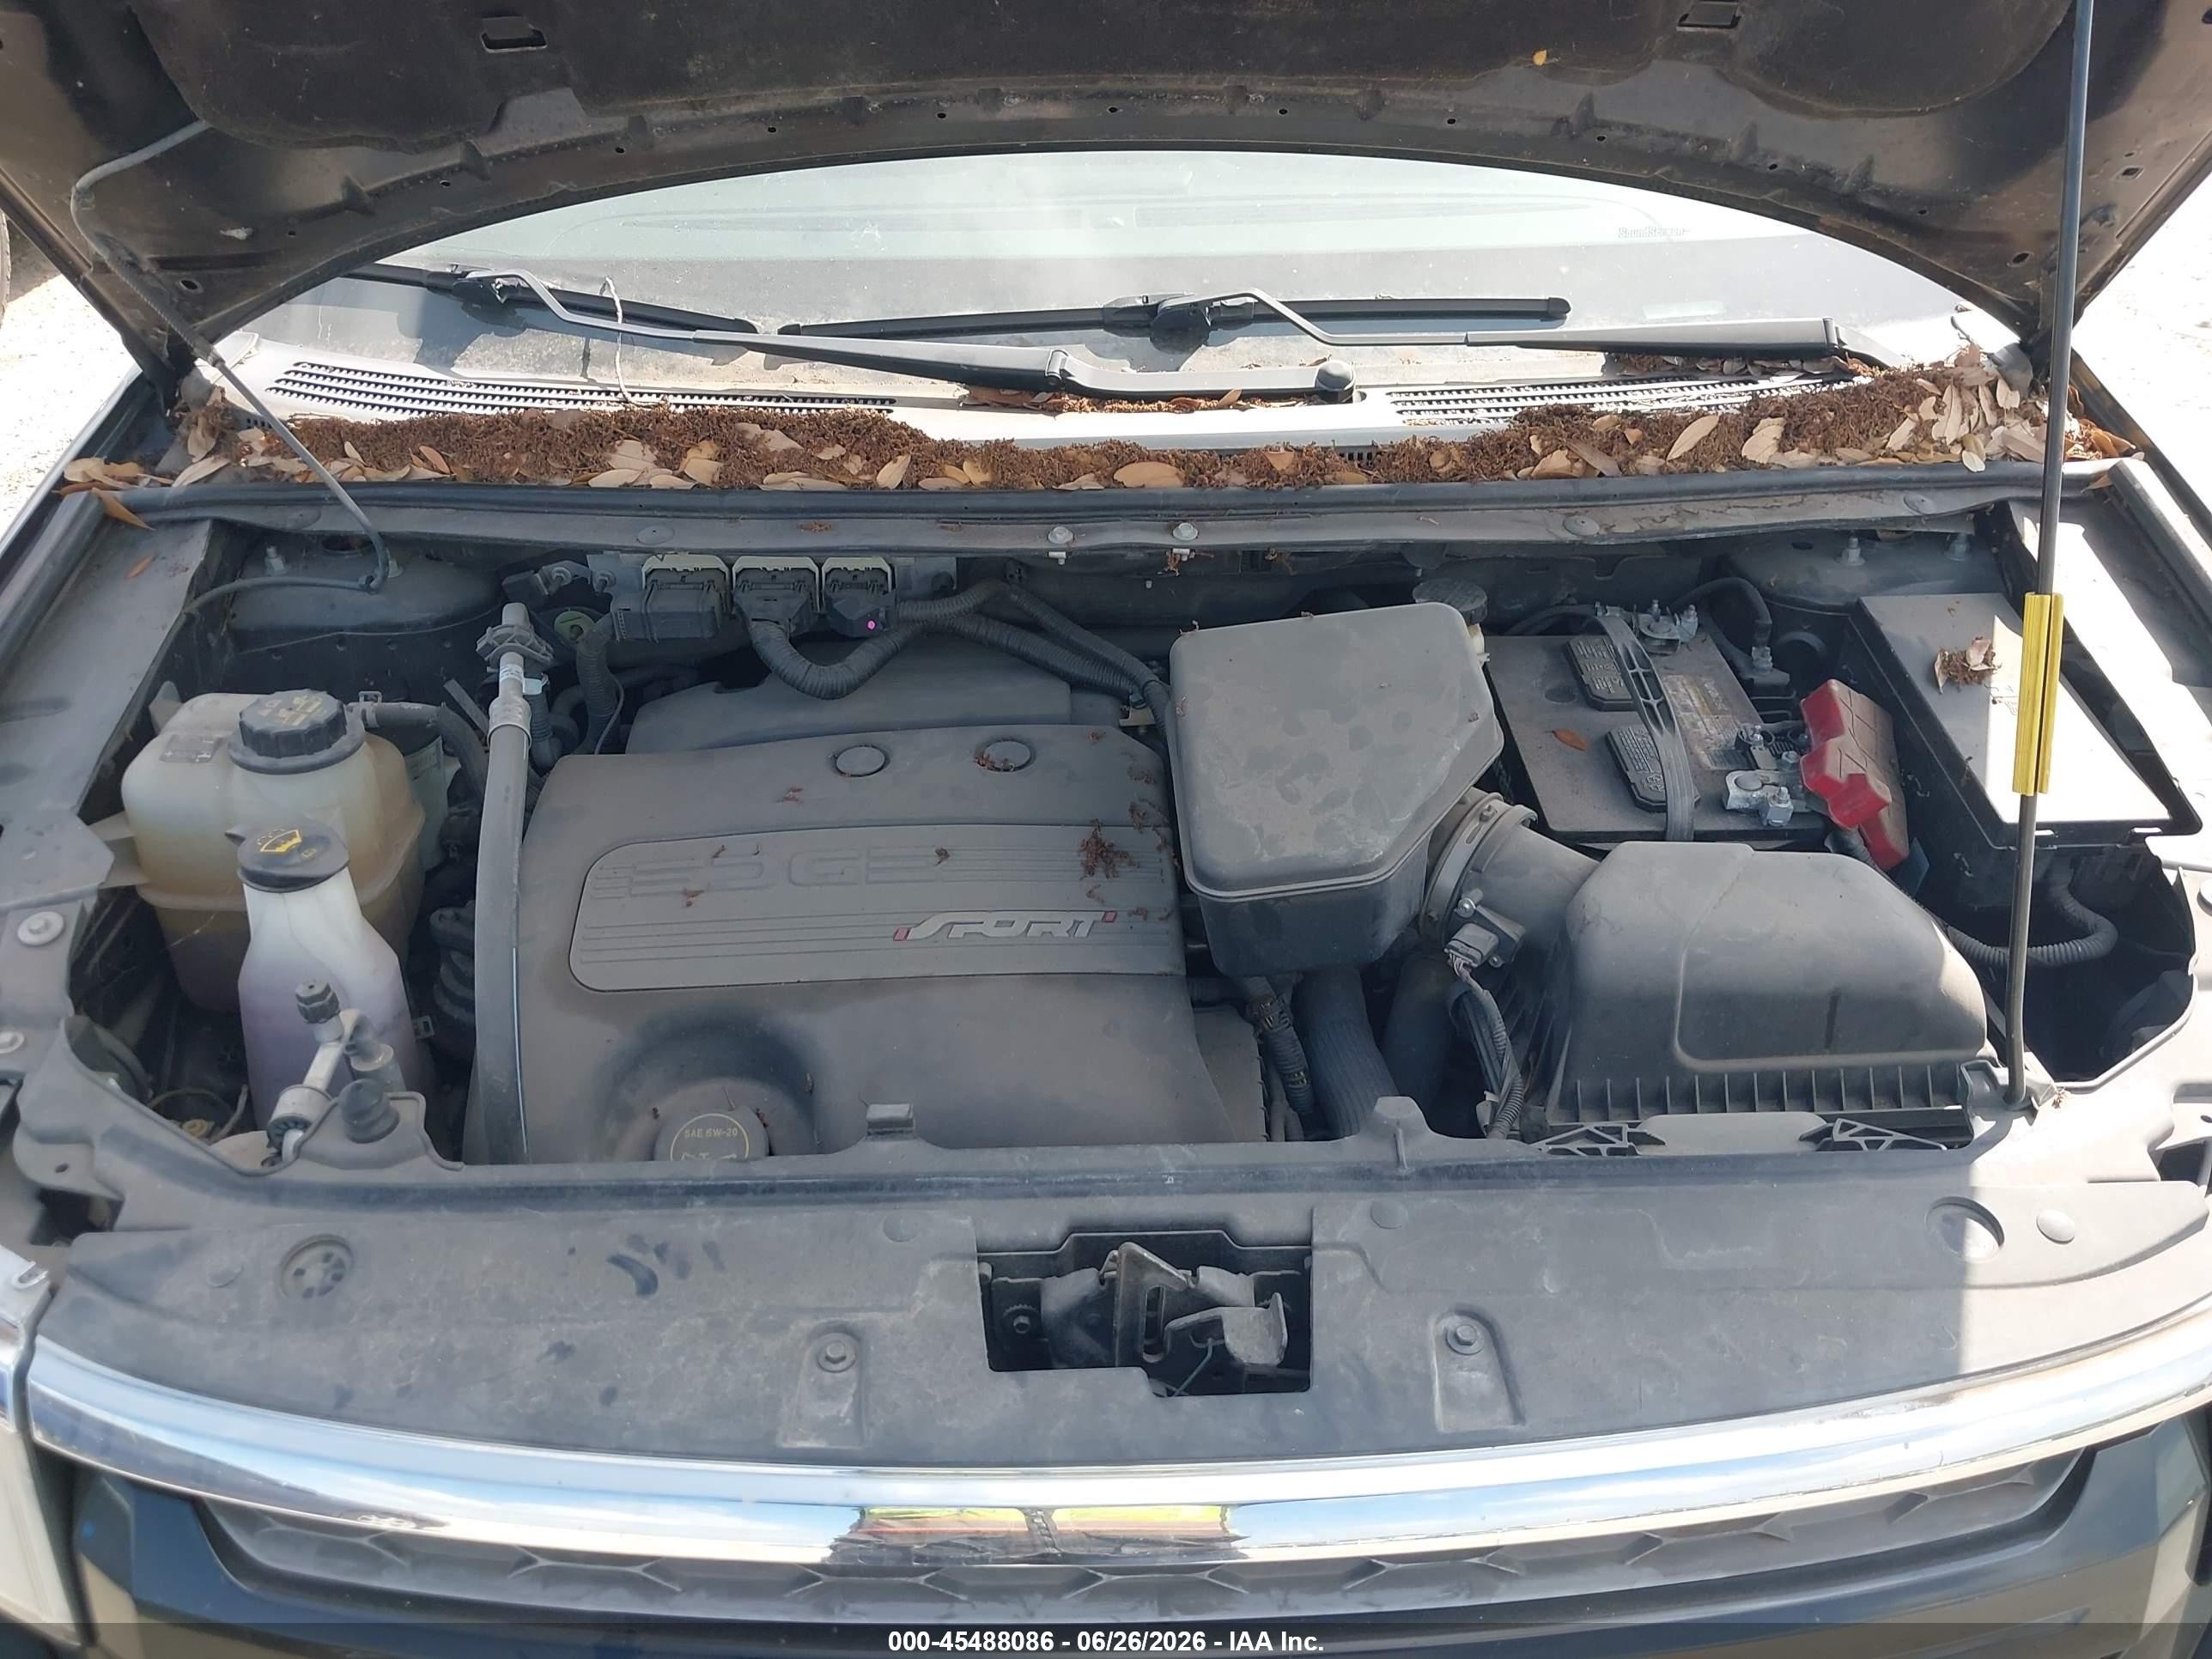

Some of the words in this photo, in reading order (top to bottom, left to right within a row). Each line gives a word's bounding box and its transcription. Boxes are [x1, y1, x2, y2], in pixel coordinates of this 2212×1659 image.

[630, 845, 936, 896] EDGE
[906, 910, 1103, 939] SPORT
[684, 1128, 703, 1139] SAE
